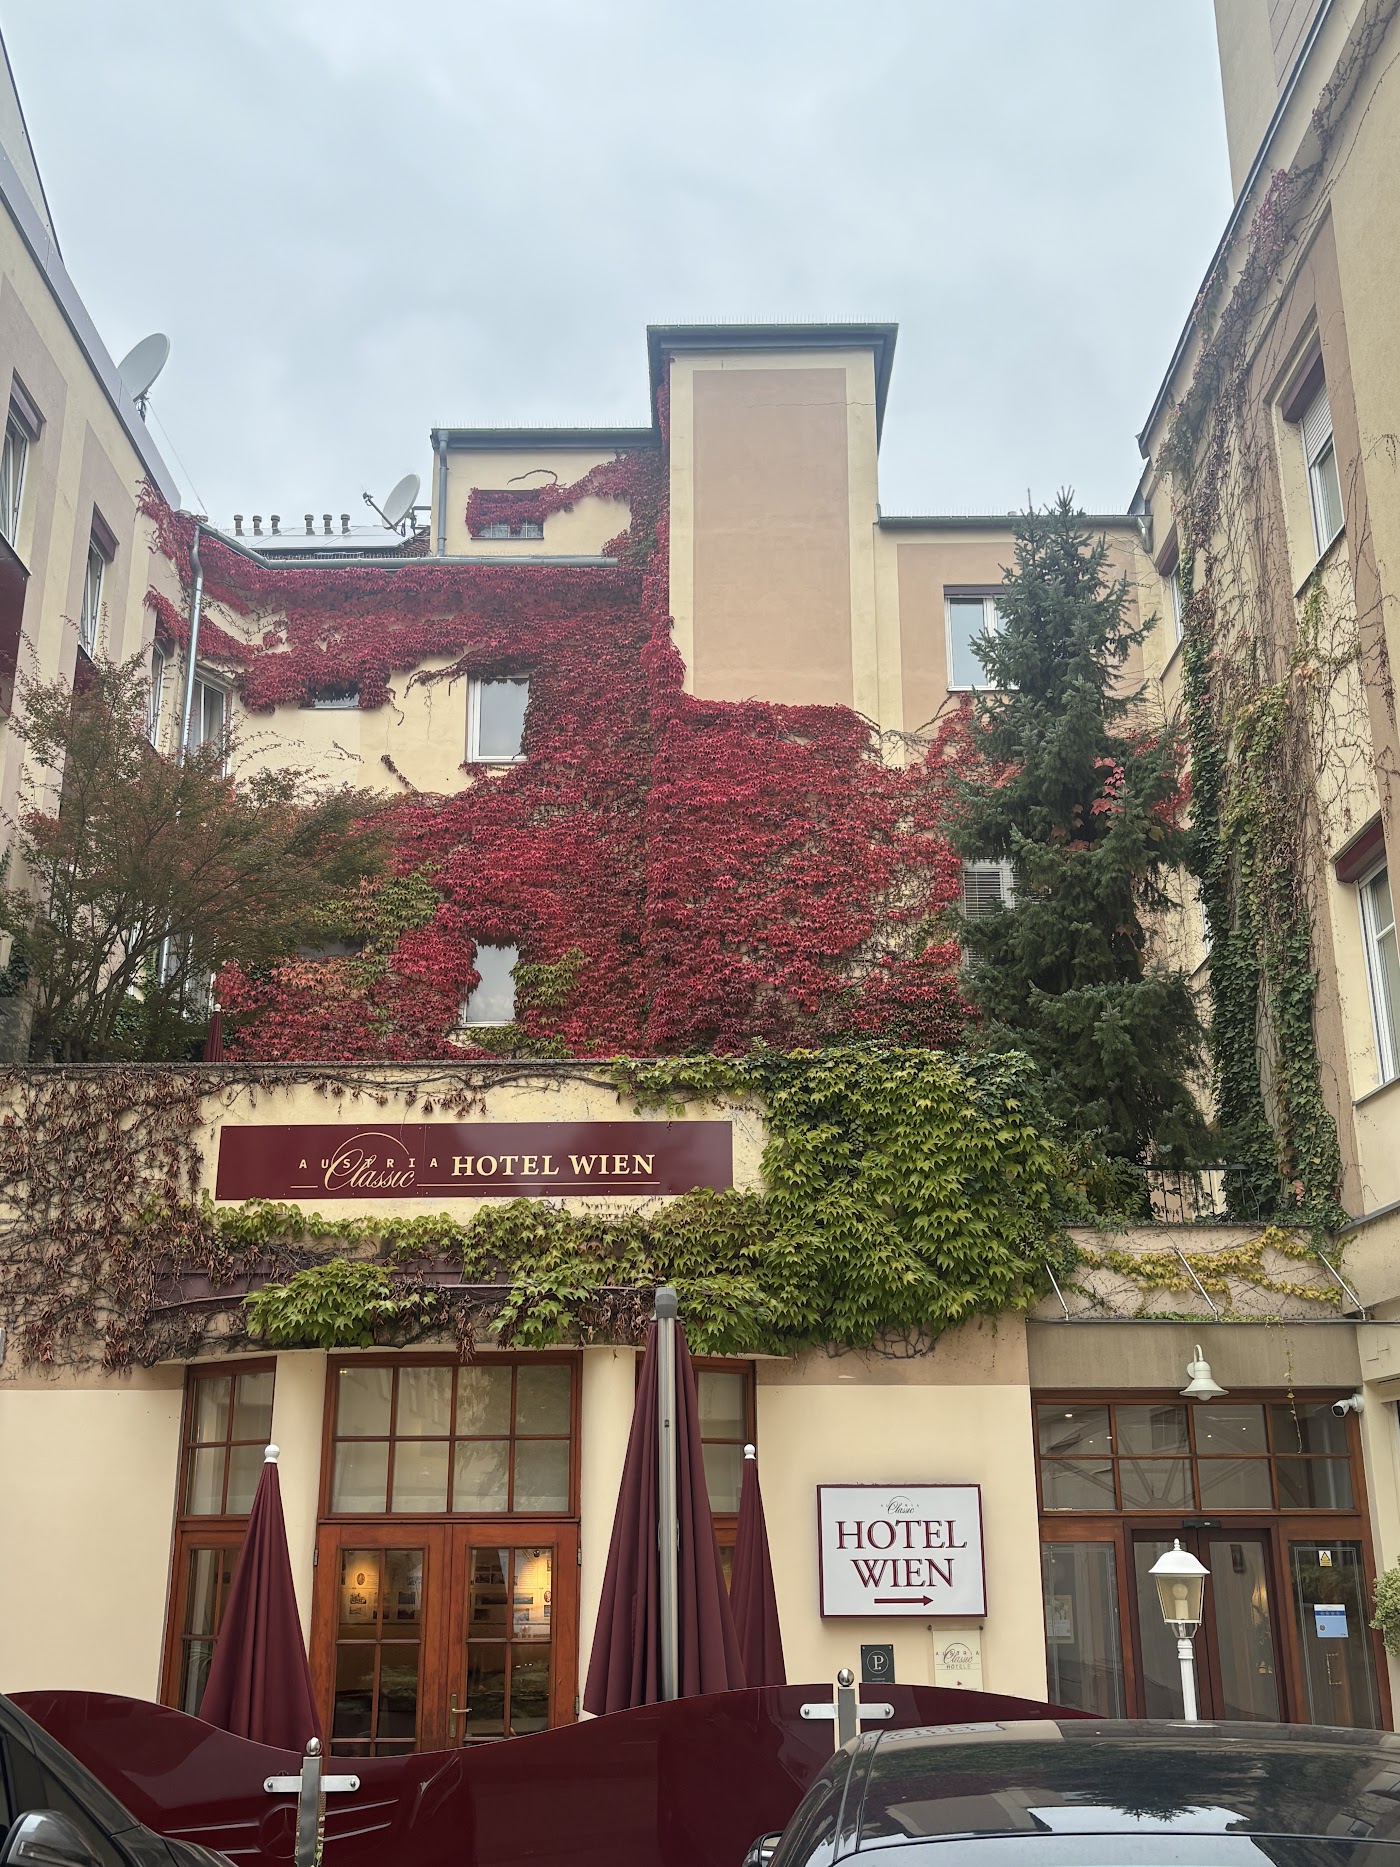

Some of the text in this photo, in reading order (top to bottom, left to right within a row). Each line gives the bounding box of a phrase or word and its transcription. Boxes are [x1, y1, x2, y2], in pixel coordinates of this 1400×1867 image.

[298, 1157, 439, 1169] AUSTRIA
[324, 1148, 416, 1191] Classic
[451, 1154, 655, 1176] HOTEL WIEN
[835, 1519, 968, 1550] HOTEL
[850, 1557, 955, 1588] WIEN
